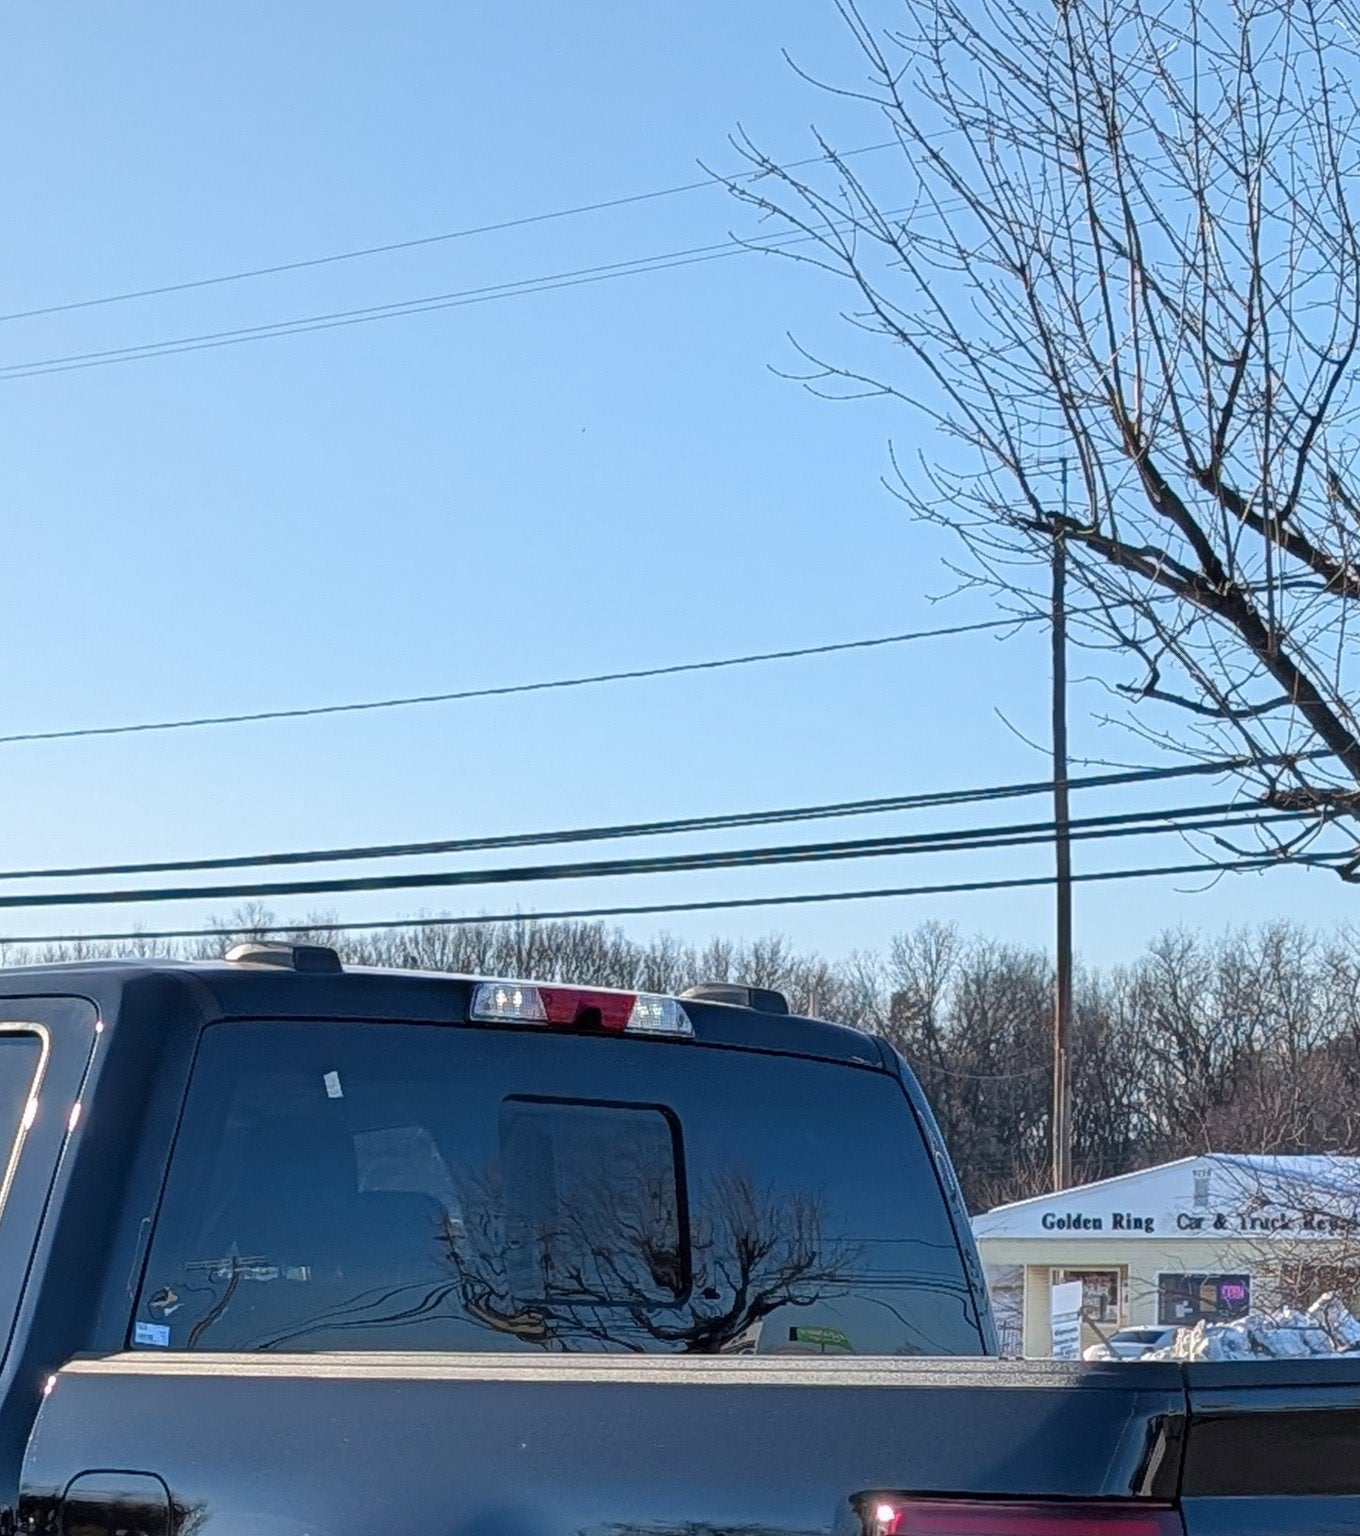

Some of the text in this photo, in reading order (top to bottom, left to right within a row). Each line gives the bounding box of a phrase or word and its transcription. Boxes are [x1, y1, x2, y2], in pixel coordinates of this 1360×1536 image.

[1041, 1213, 1103, 1231] Golden
[1111, 1213, 1155, 1233] Ring
[1176, 1213, 1204, 1230] Car
[1213, 1213, 1227, 1230] &
